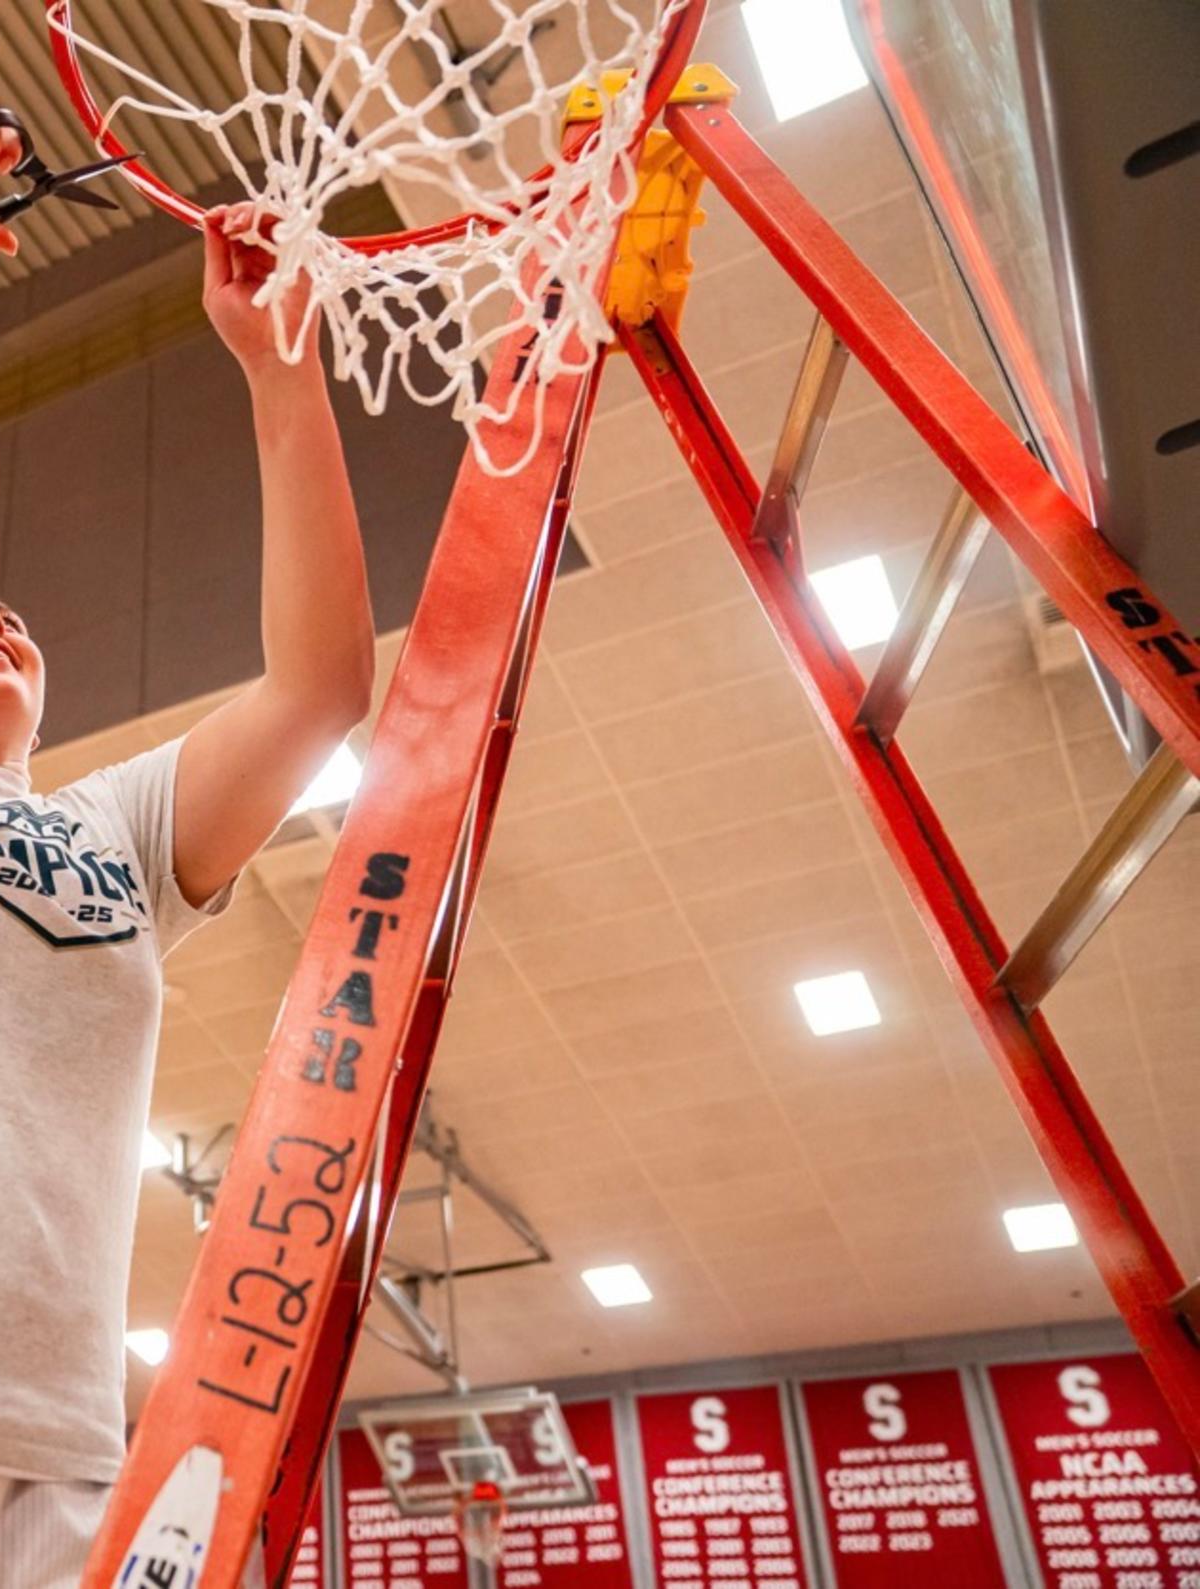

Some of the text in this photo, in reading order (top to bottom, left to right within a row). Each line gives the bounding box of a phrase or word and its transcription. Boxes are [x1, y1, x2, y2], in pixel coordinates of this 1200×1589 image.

[1058, 1366, 1110, 1427] S
[690, 1396, 730, 1452] S
[862, 1383, 907, 1441] S
[1091, 1431, 1159, 1449] SOCCER
[381, 1434, 415, 1482] S
[1060, 1452, 1148, 1479] NCAA
[653, 1473, 783, 1497] CONFERENCE
[826, 1462, 971, 1489] CONFERENCE
[829, 1485, 976, 1510] CHAMPIONS
[1031, 1476, 1196, 1501] APPEARANCES
[655, 1496, 787, 1518] CHAMPIONS
[348, 1518, 459, 1542] CHAMPIONS
[1159, 1524, 1200, 1544] 200
